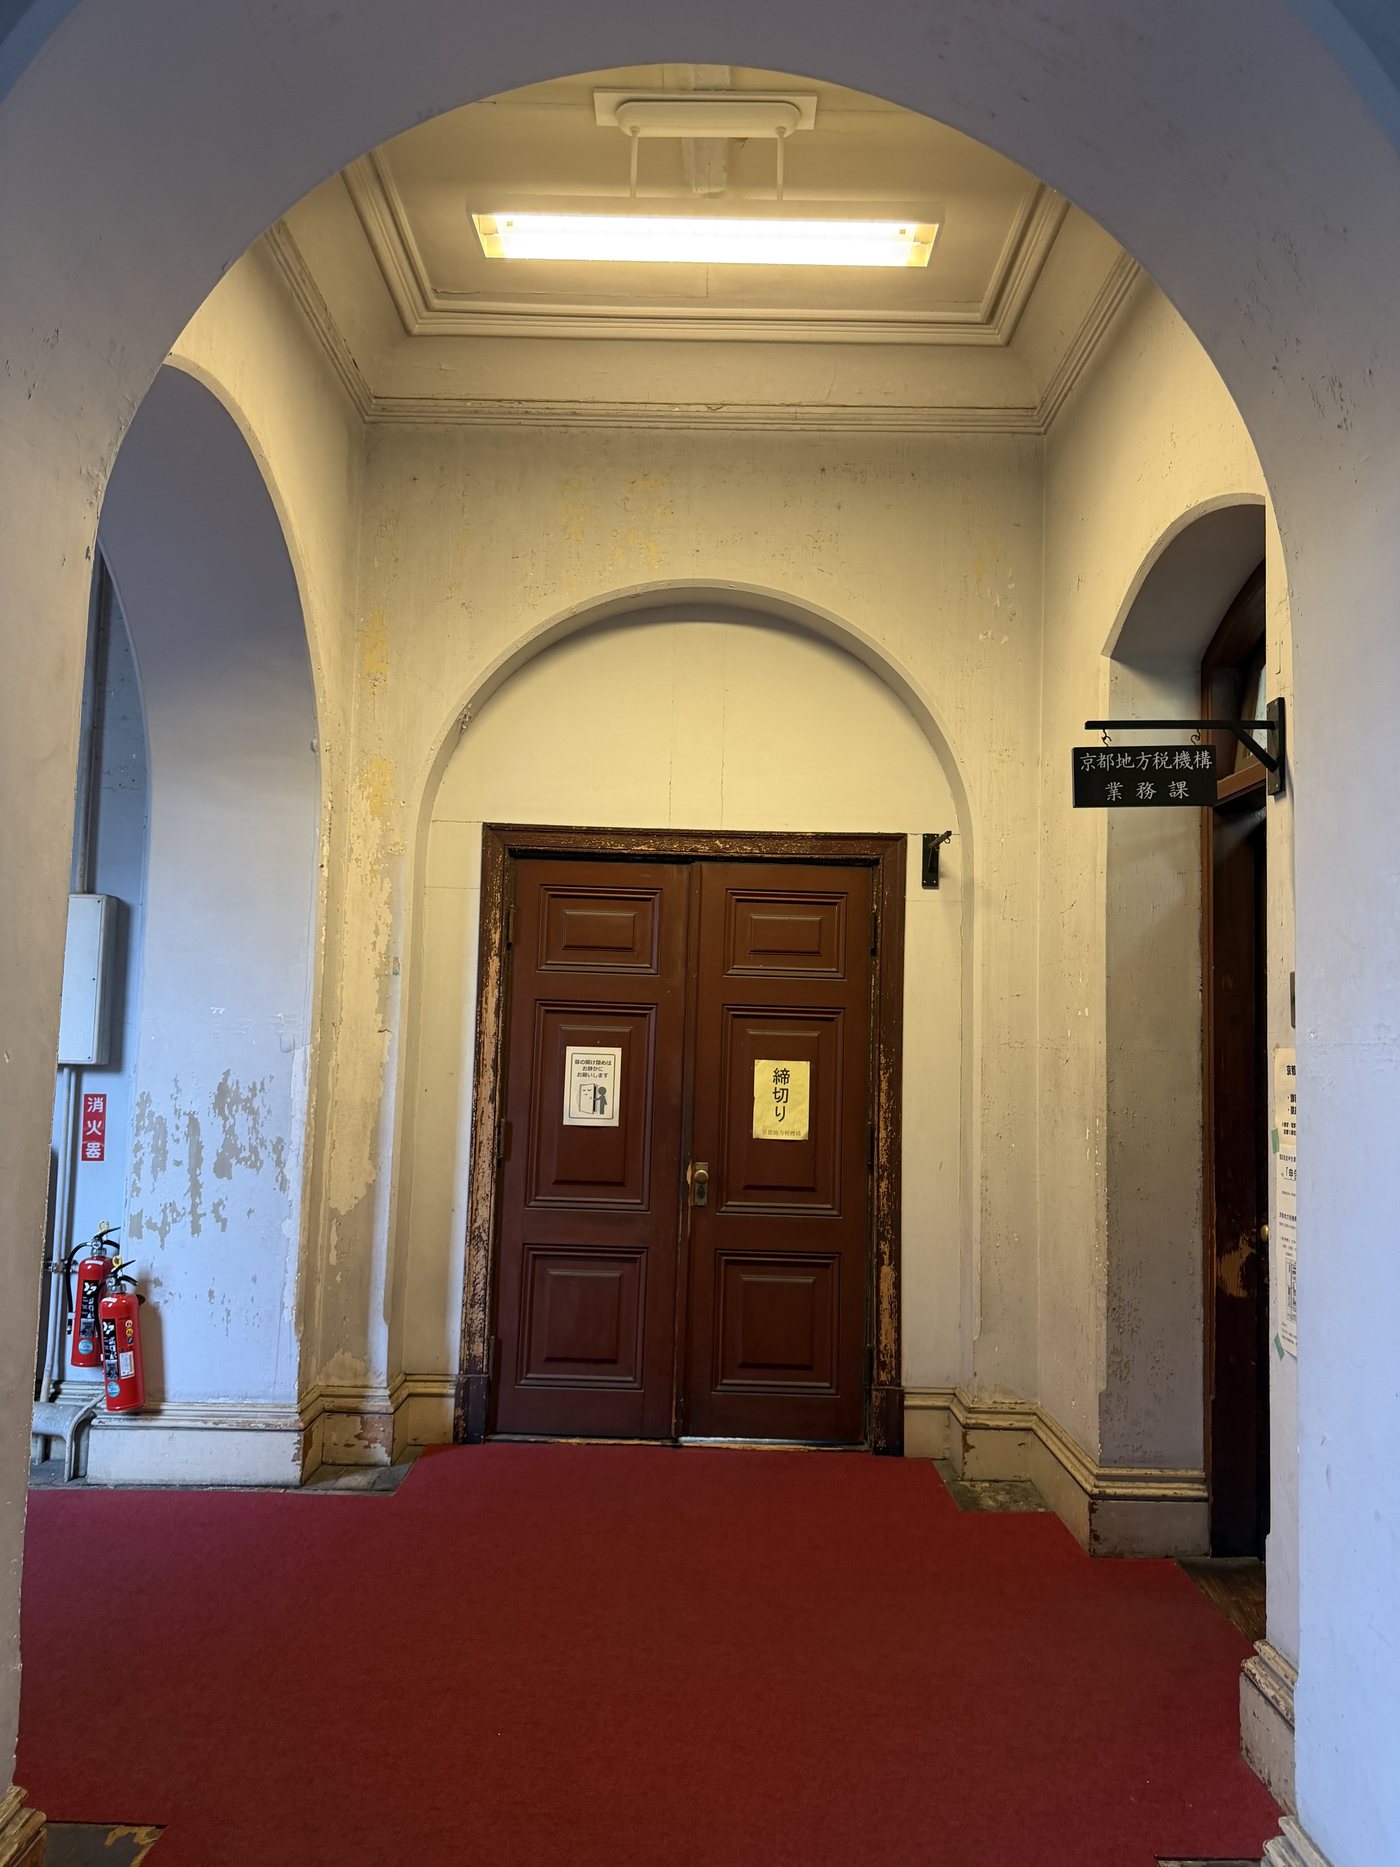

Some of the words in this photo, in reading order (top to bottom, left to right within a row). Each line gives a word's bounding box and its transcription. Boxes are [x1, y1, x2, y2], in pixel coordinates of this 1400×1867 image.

[1080, 750, 1213, 771] 京都地方税機構
[1105, 781, 1190, 802] 業務課
[772, 1068, 790, 1122] 締切り
[86, 1097, 103, 1159] 消火器
